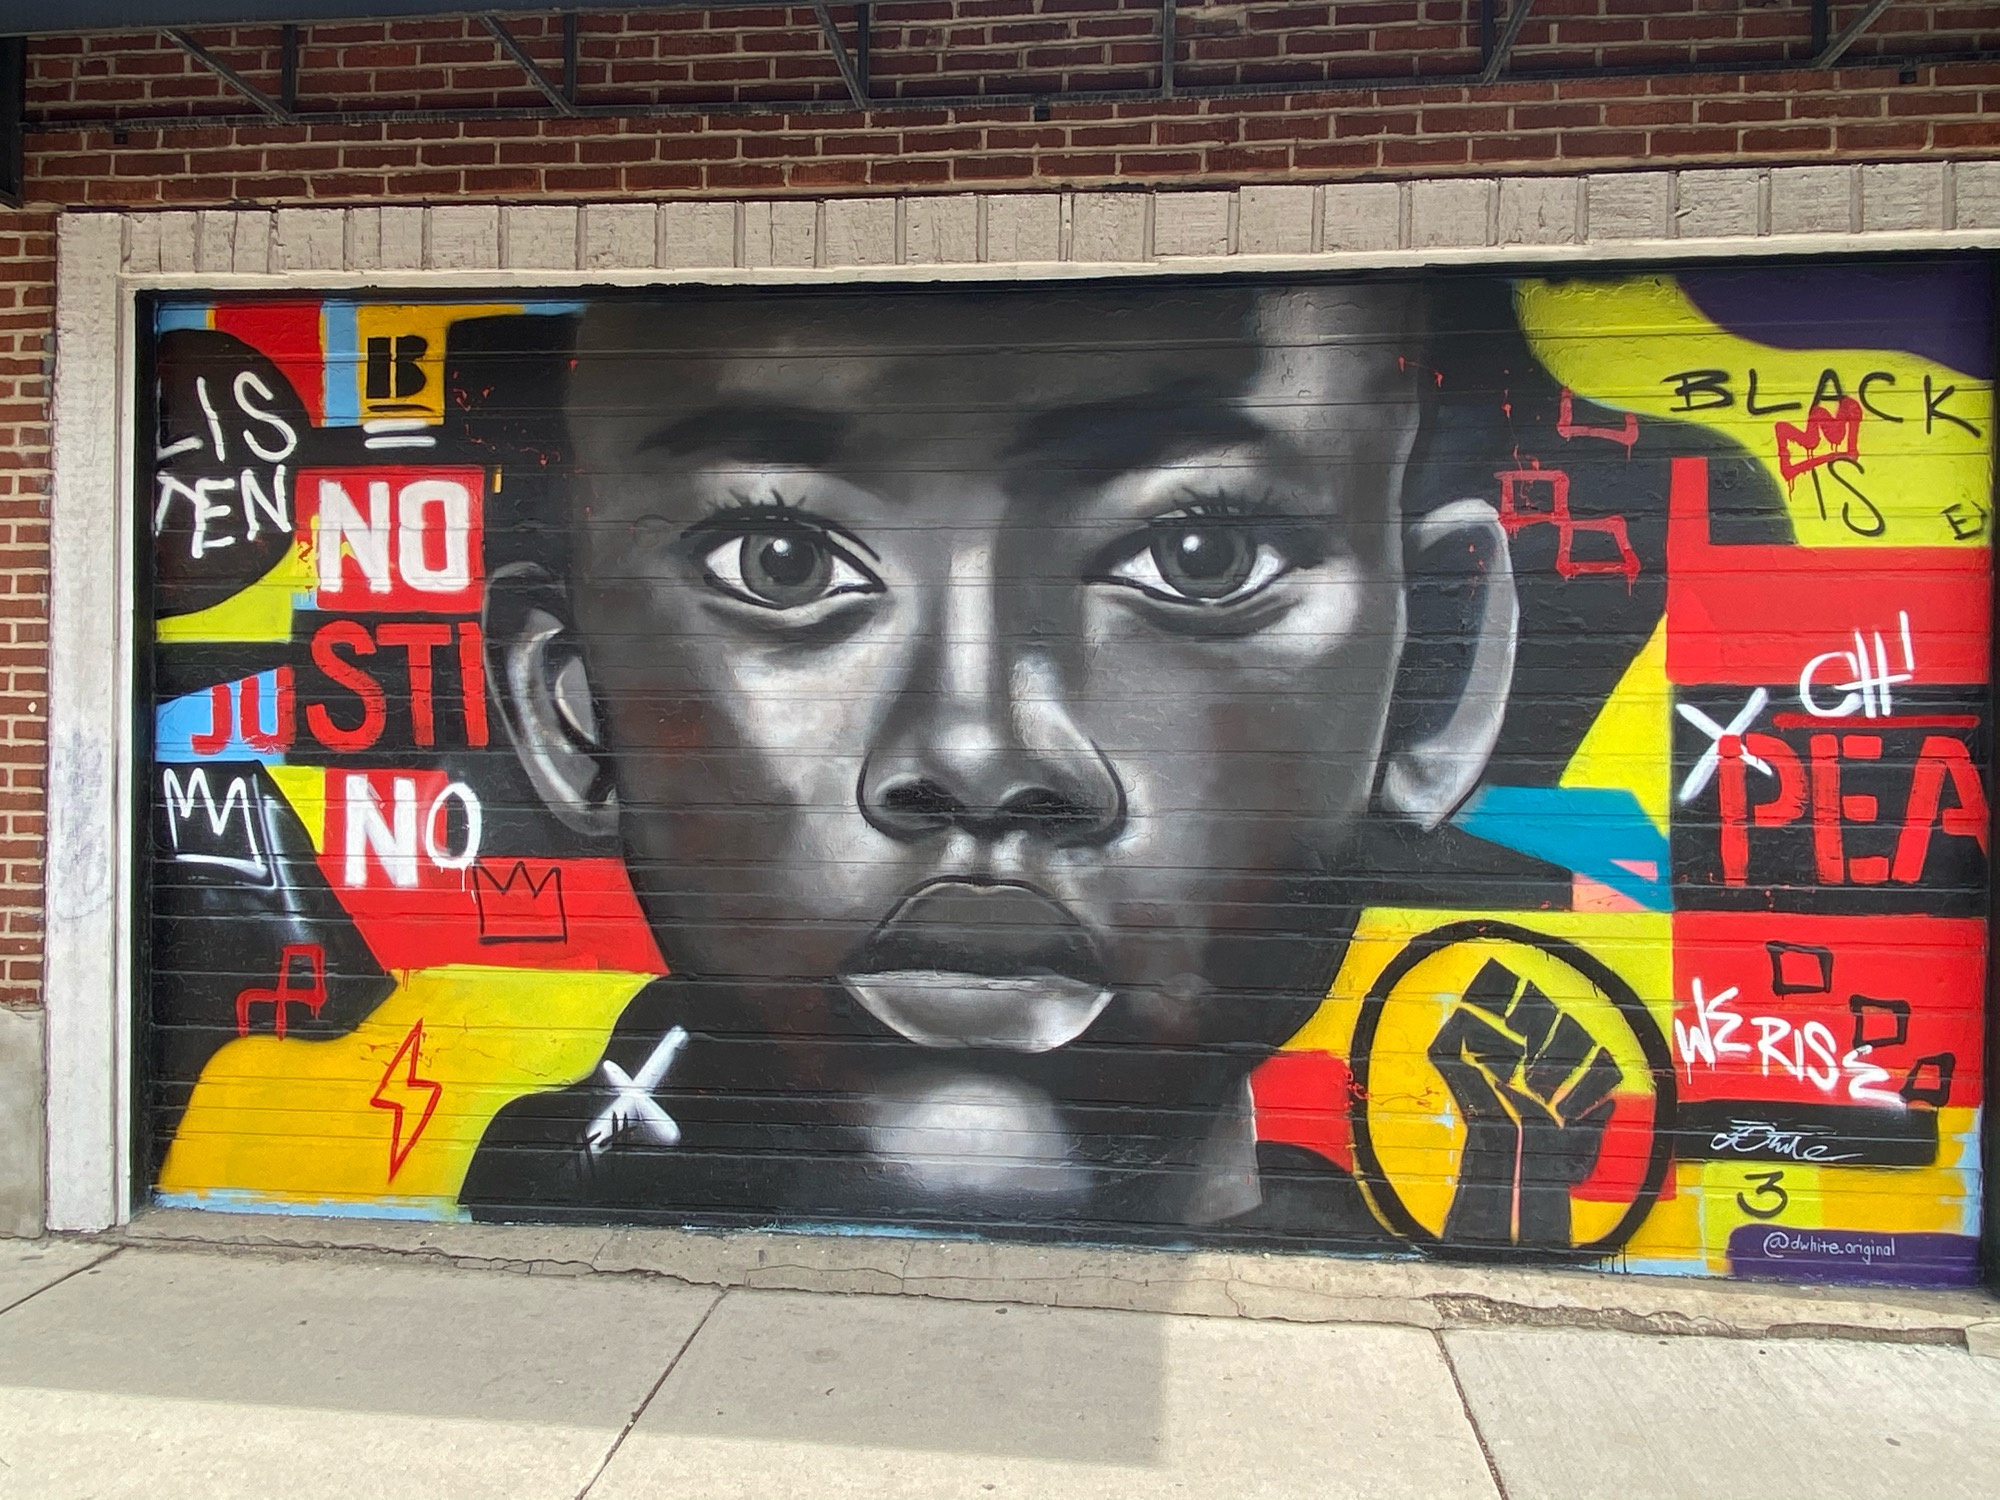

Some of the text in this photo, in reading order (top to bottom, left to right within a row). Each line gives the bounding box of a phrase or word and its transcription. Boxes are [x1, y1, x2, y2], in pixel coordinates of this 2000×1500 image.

[366, 335, 428, 399] B
[1661, 368, 1981, 438] BLACK
[155, 464, 292, 559] TEN
[318, 479, 469, 593] NO
[1810, 457, 1886, 537] IS
[344, 772, 482, 888] NO
[1717, 732, 1989, 888] PEA
[1674, 977, 1907, 1107] WE RISE
[1736, 1170, 1789, 1219] 3
[1762, 1231, 1896, 1265] @dwhite.original
